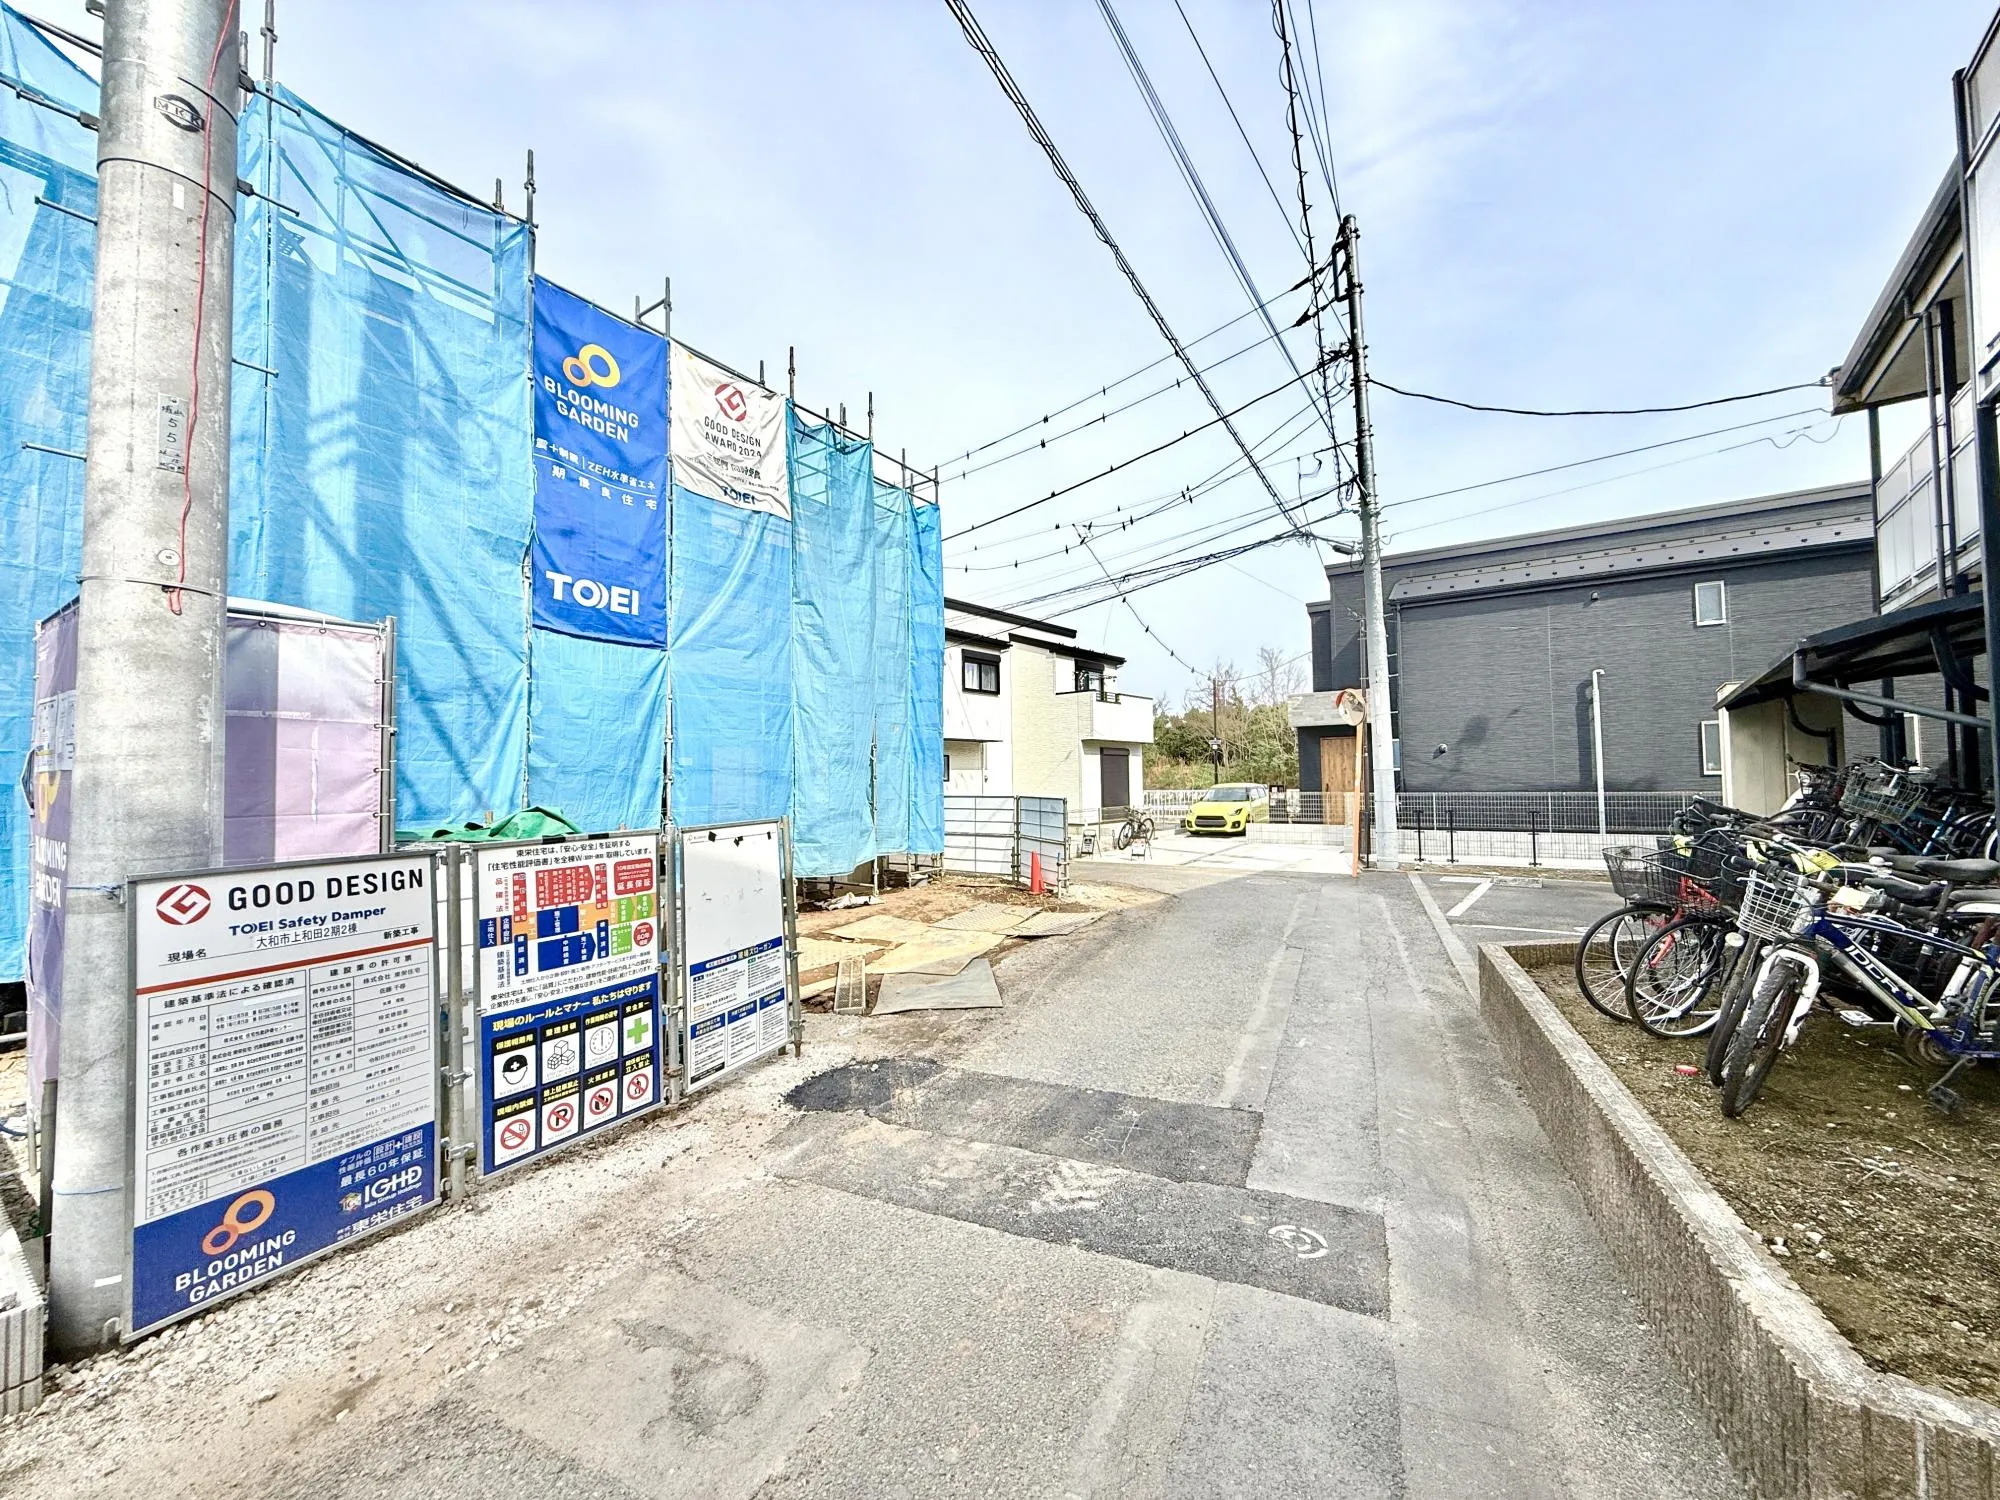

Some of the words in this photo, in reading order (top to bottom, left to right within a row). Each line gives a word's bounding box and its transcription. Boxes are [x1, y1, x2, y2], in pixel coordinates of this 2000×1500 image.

[157, 100, 202, 128] MKK
[544, 375, 639, 428] BLOOMING
[556, 400, 628, 443] GARDEN
[704, 416, 728, 436] GOOD
[731, 428, 761, 447] DESIGN
[704, 431, 737, 452] AWARD
[587, 461, 656, 490] ZEH水準省エネ
[545, 570, 640, 616] TOEI
[228, 880, 315, 911] GOOD
[326, 868, 424, 899] DESIGN
[229, 920, 273, 936] TOEI
[279, 914, 327, 930] Safety
[331, 905, 386, 924] Damper
[256, 923, 358, 949] 大和市上和田2期2棟
[384, 927, 419, 940] 新築工事
[487, 920, 495, 945] 土地仕入
[167, 949, 207, 962] 現場名
[330, 955, 412, 976] 建設業の許可票
[163, 977, 295, 1009] 建築基準法による確認済
[493, 1001, 590, 1031] 現場のルールとマナー
[592, 982, 652, 1006] 私たちは守ります
[626, 1002, 650, 1013] 安全第一
[177, 1119, 283, 1158] 各作業主任者の職務
[340, 1150, 371, 1166] ダブルの
[340, 1148, 424, 1188] 最長60年保証
[364, 1165, 422, 1203] IGHD
[351, 1195, 423, 1233] 東栄住宅
[175, 1229, 296, 1292] BLOOMING
[189, 1251, 283, 1303] GARDEN
